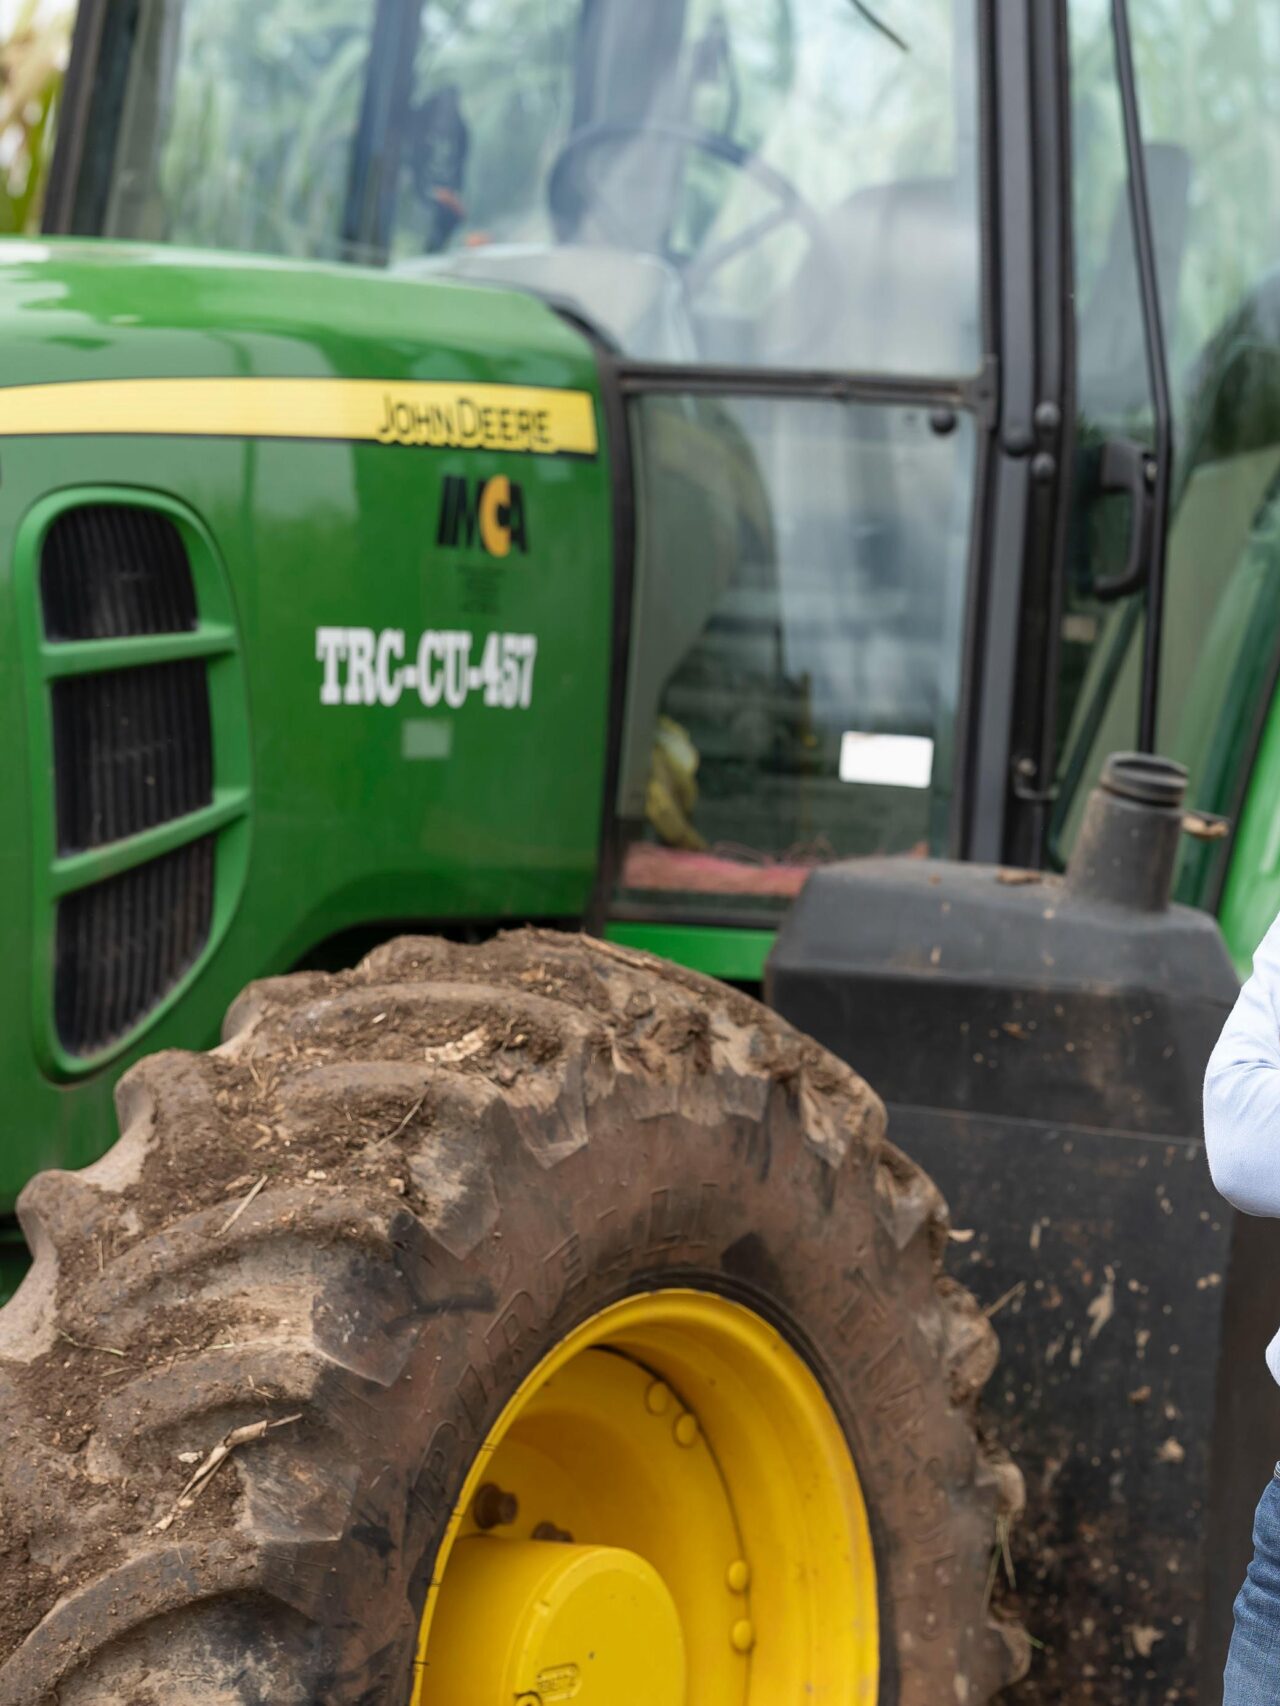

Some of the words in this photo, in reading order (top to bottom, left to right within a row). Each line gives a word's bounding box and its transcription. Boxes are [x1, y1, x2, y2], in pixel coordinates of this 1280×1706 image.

[379, 392, 453, 435] JOHN
[457, 398, 552, 444] DEERE
[315, 626, 537, 709] TRC-CU-457
